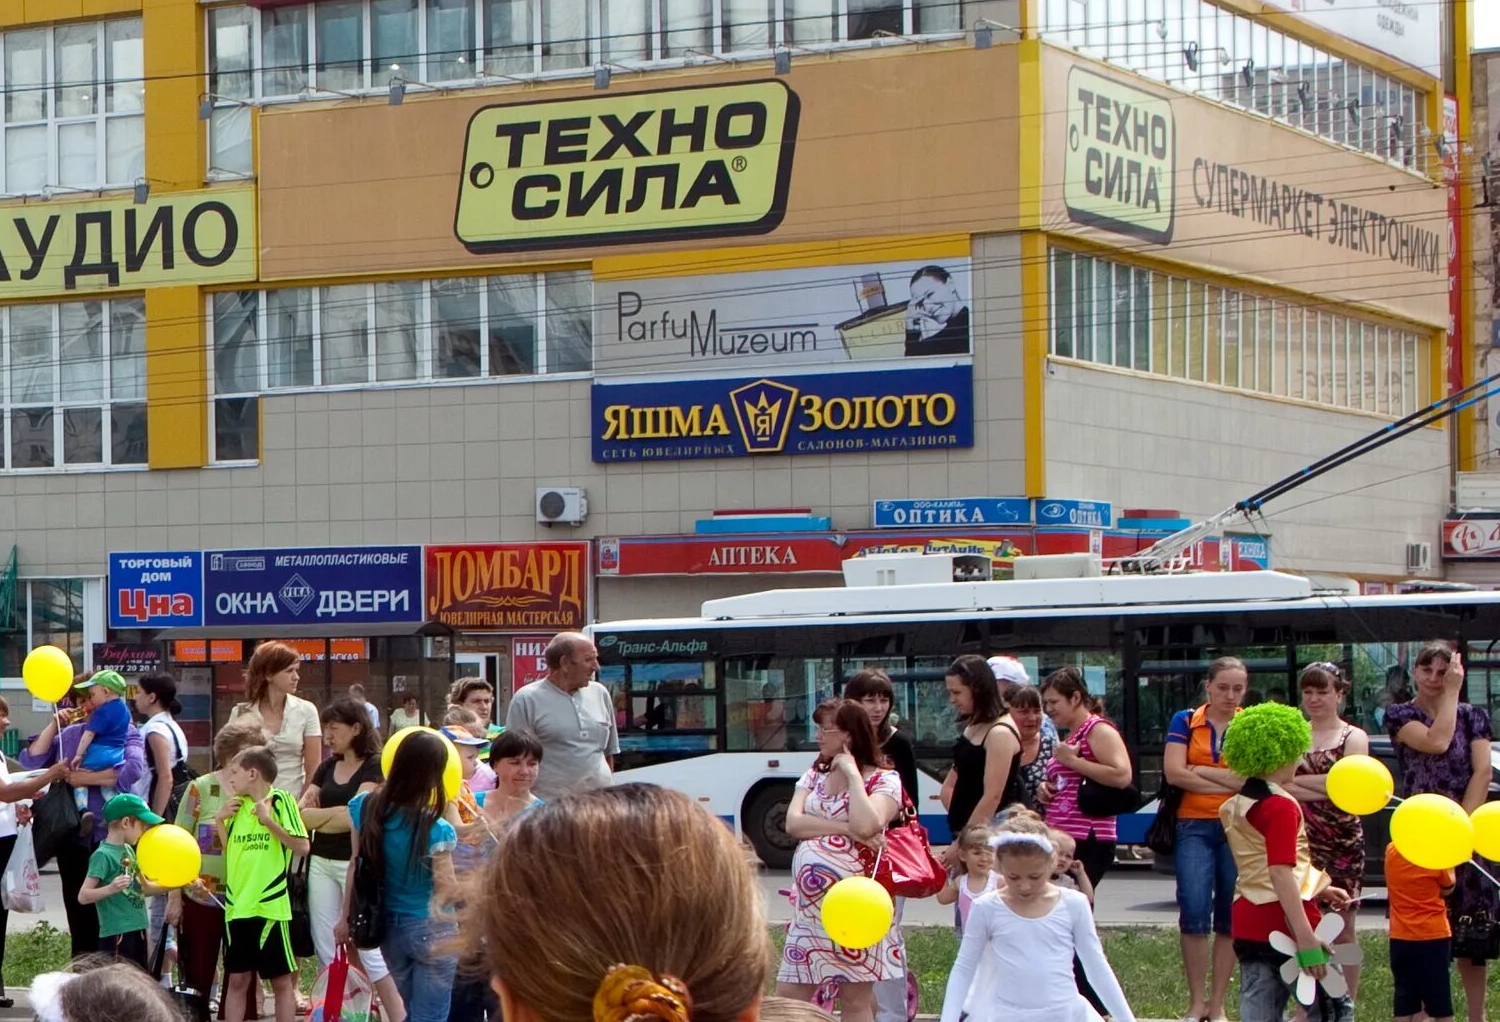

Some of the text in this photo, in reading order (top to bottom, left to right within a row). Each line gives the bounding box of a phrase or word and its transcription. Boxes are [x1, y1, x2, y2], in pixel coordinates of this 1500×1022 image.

[496, 100, 768, 171] ТЕХНО
[1078, 88, 1167, 161] ТЕХНО
[510, 158, 741, 222] СИЛА
[1084, 146, 1162, 214] СИЛА
[1192, 156, 1440, 277] СУПЕРМАРКЕТ ЭЛЕКТРОНИКИ
[601, 403, 732, 441] ЯШМА
[798, 392, 957, 432] ЗОЛОТО
[602, 434, 958, 460] СЕТЬ ЮВЕЛИРНЫХ САЛОНОВ-МАГАЗИНОВ
[893, 506, 985, 525] ОПТИКА
[1069, 508, 1102, 525] ОПТИКА
[119, 555, 193, 569] ТОРГОВЫЙ
[274, 553, 409, 567] МЕТАЛЛОПЛАСТИКОВЫЕ
[708, 545, 798, 566] АПТЕКА
[140, 572, 172, 584] ДОМ
[430, 548, 581, 619] ЛОМБАРД
[118, 588, 194, 622] Цна
[215, 591, 278, 615] ОКНА
[316, 589, 410, 617] ДВЕРИ
[440, 611, 574, 626] ЮВЕЛИРНАЯ МАСТЕРСКАЯ
[617, 637, 708, 656] Транс-Альфа
